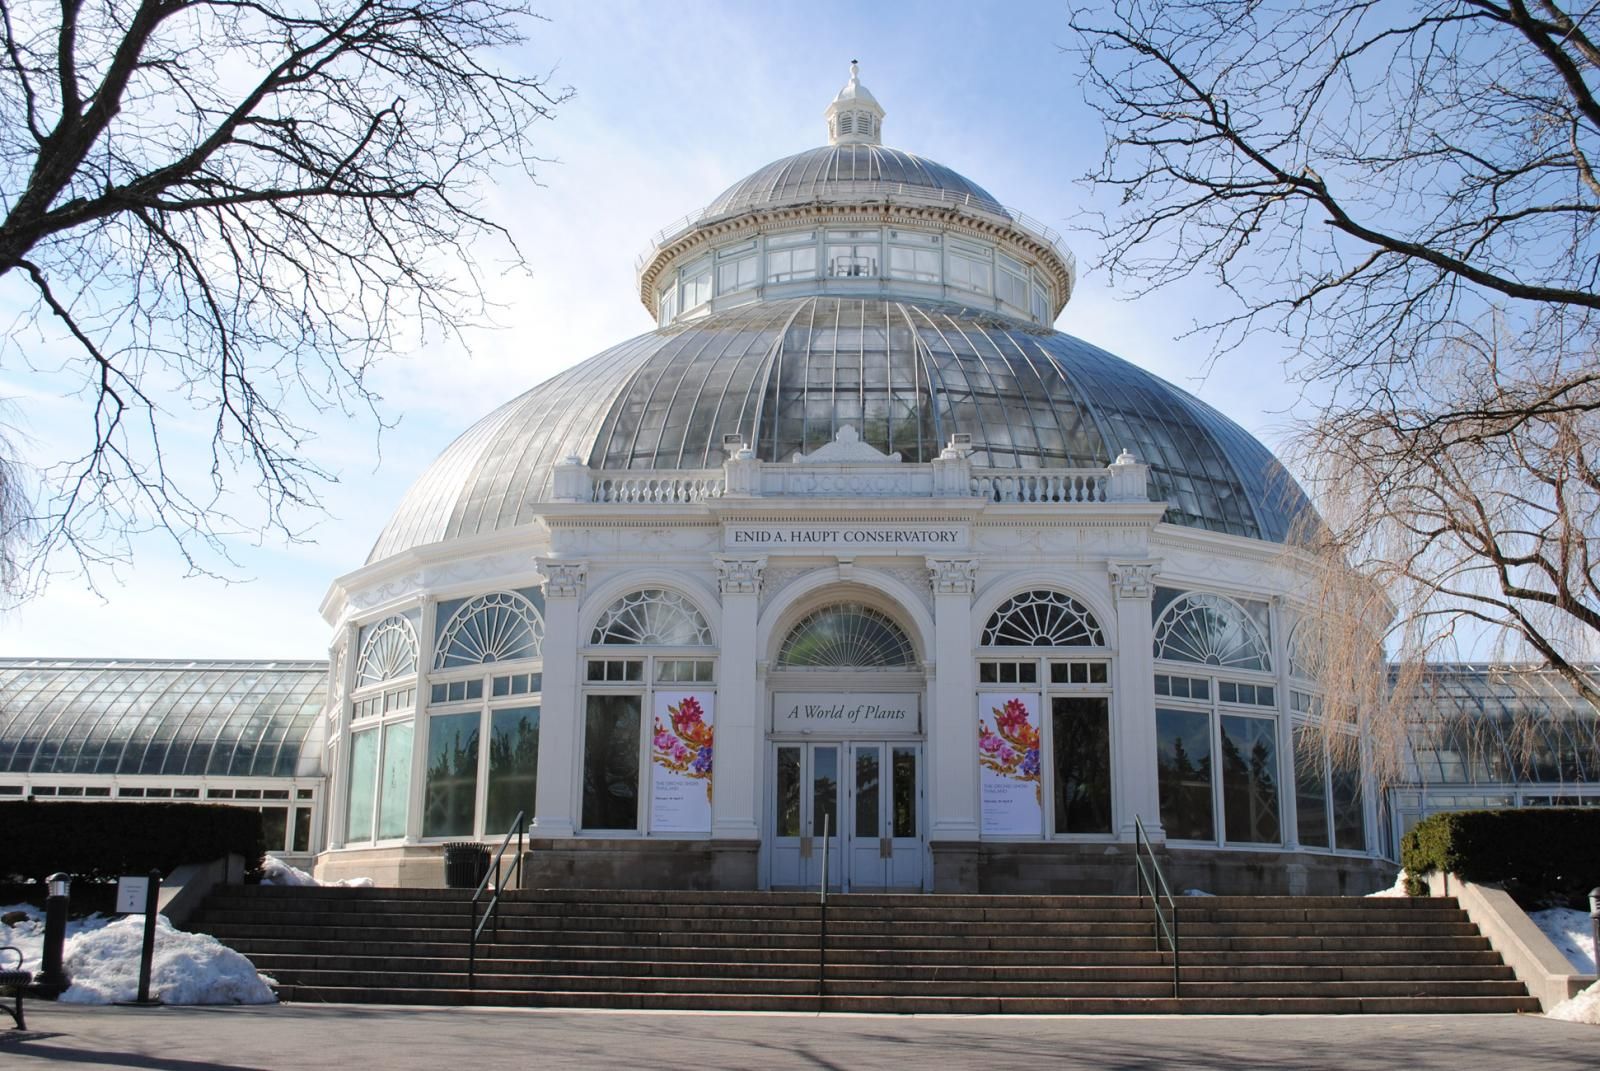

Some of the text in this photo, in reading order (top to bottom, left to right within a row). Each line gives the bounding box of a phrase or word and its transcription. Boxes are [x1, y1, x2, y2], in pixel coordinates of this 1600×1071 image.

[735, 530, 959, 543] ENID A. HAUPT CONSERVATORY
[788, 704, 906, 723] A World of Plants
